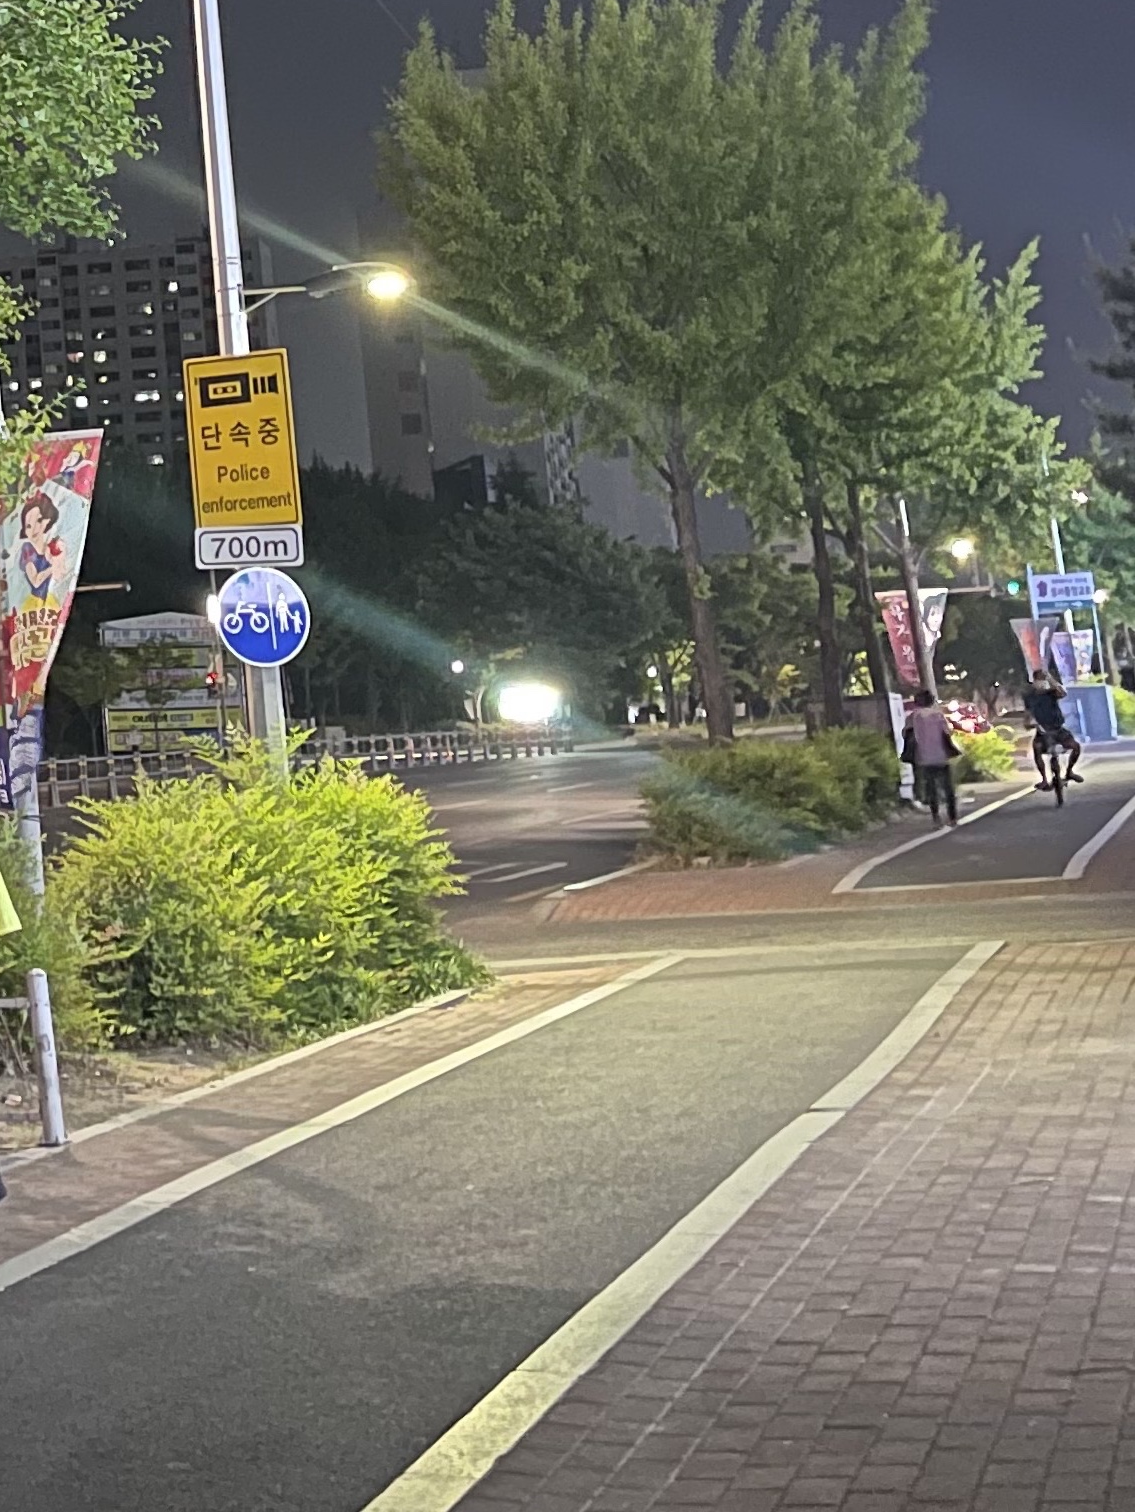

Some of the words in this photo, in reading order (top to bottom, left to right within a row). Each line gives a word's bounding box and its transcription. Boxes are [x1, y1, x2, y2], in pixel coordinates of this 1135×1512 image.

[201, 417, 280, 451] 단속중
[217, 464, 270, 483] Police
[202, 491, 293, 513] enforcement
[210, 535, 288, 559] 700m
